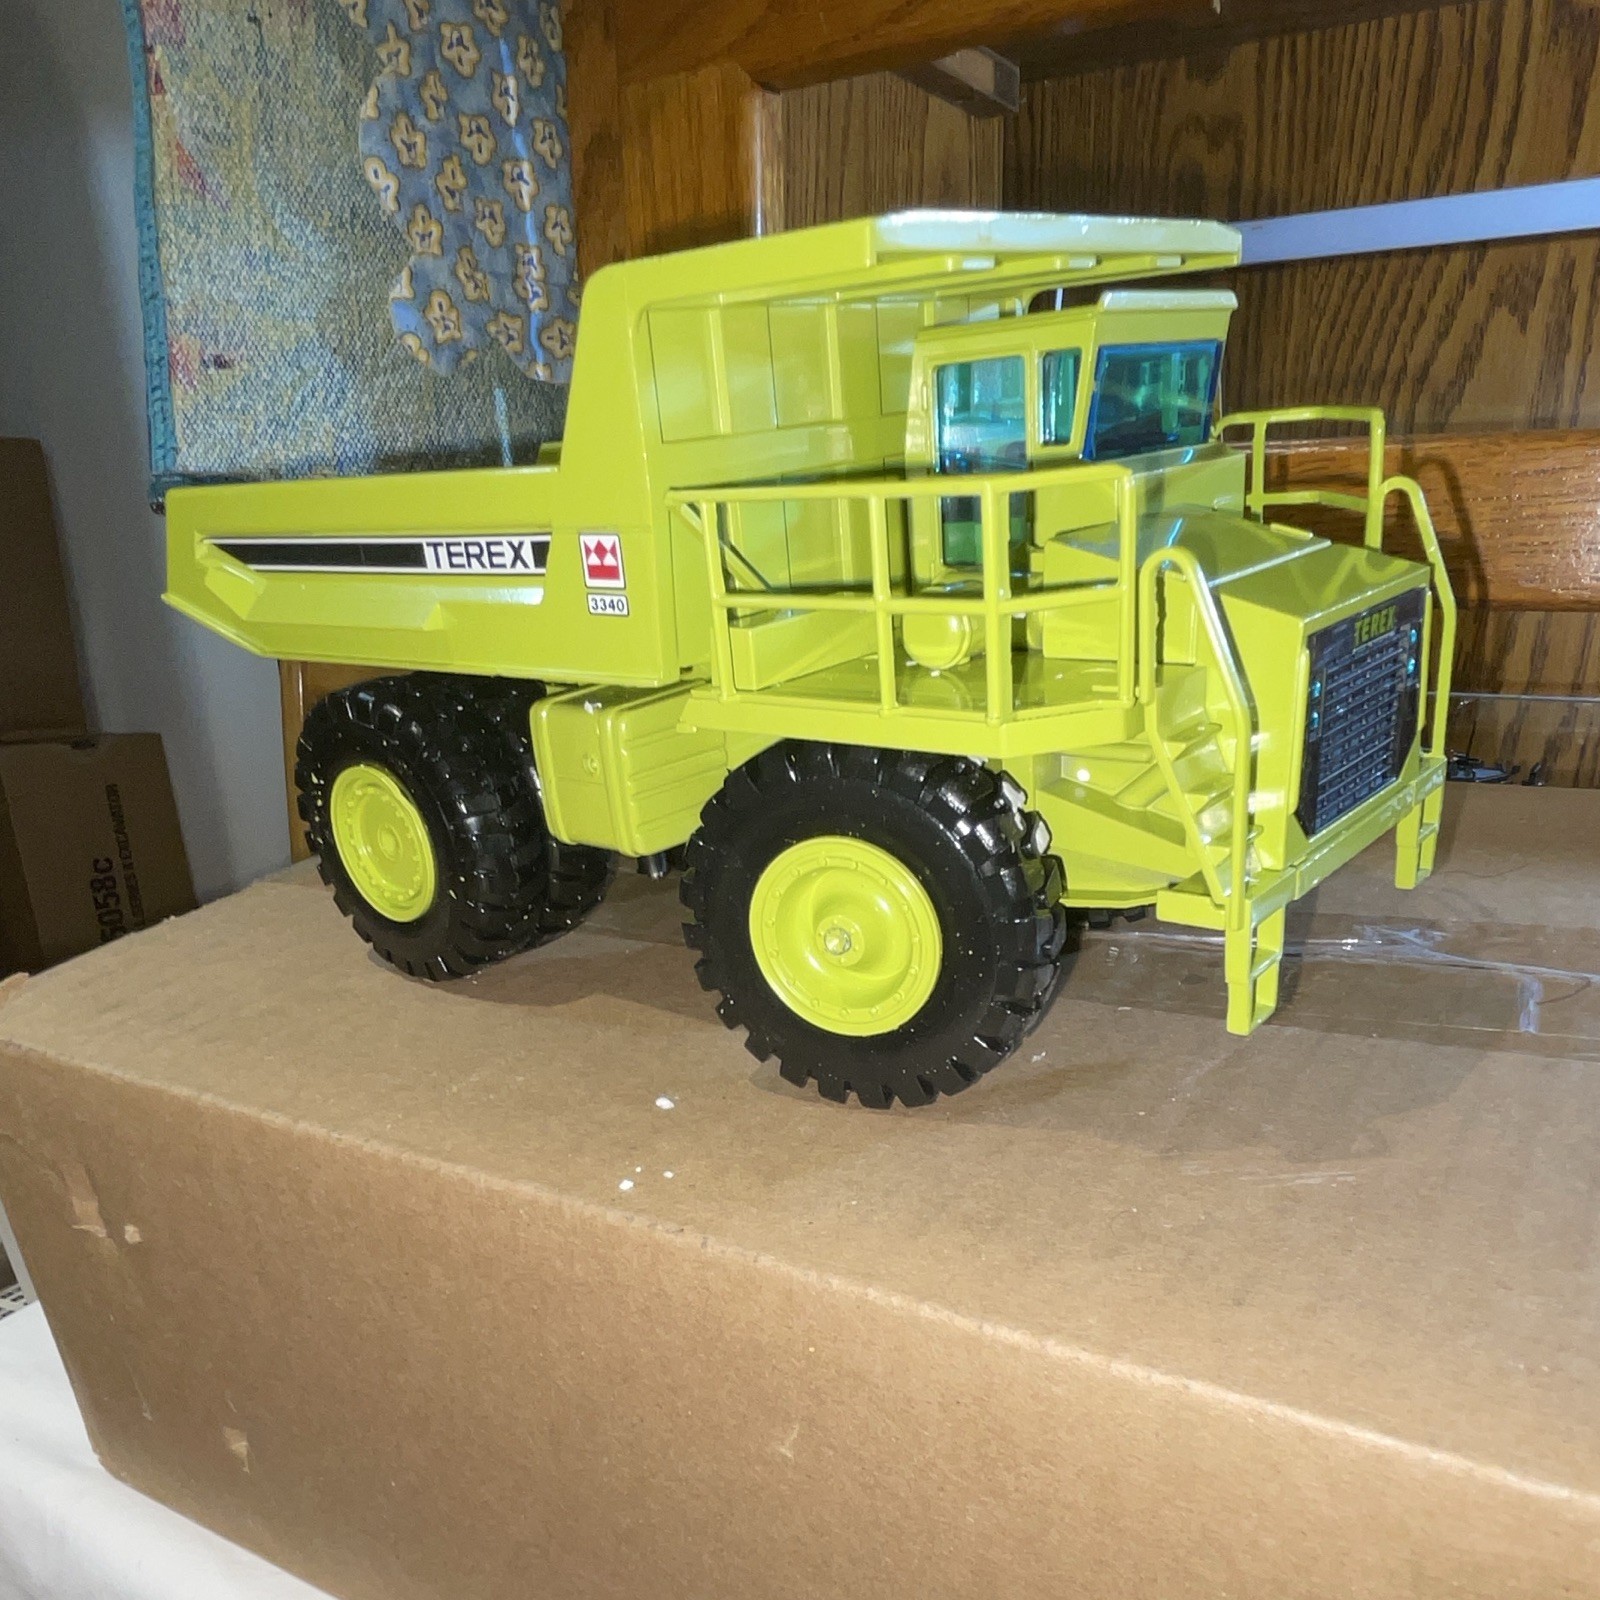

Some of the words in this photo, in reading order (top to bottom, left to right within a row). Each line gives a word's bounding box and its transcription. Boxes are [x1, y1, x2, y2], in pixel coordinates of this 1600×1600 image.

[426, 540, 531, 569] TEREX
[591, 598, 625, 613] 3340
[1354, 605, 1396, 647] TEREX
